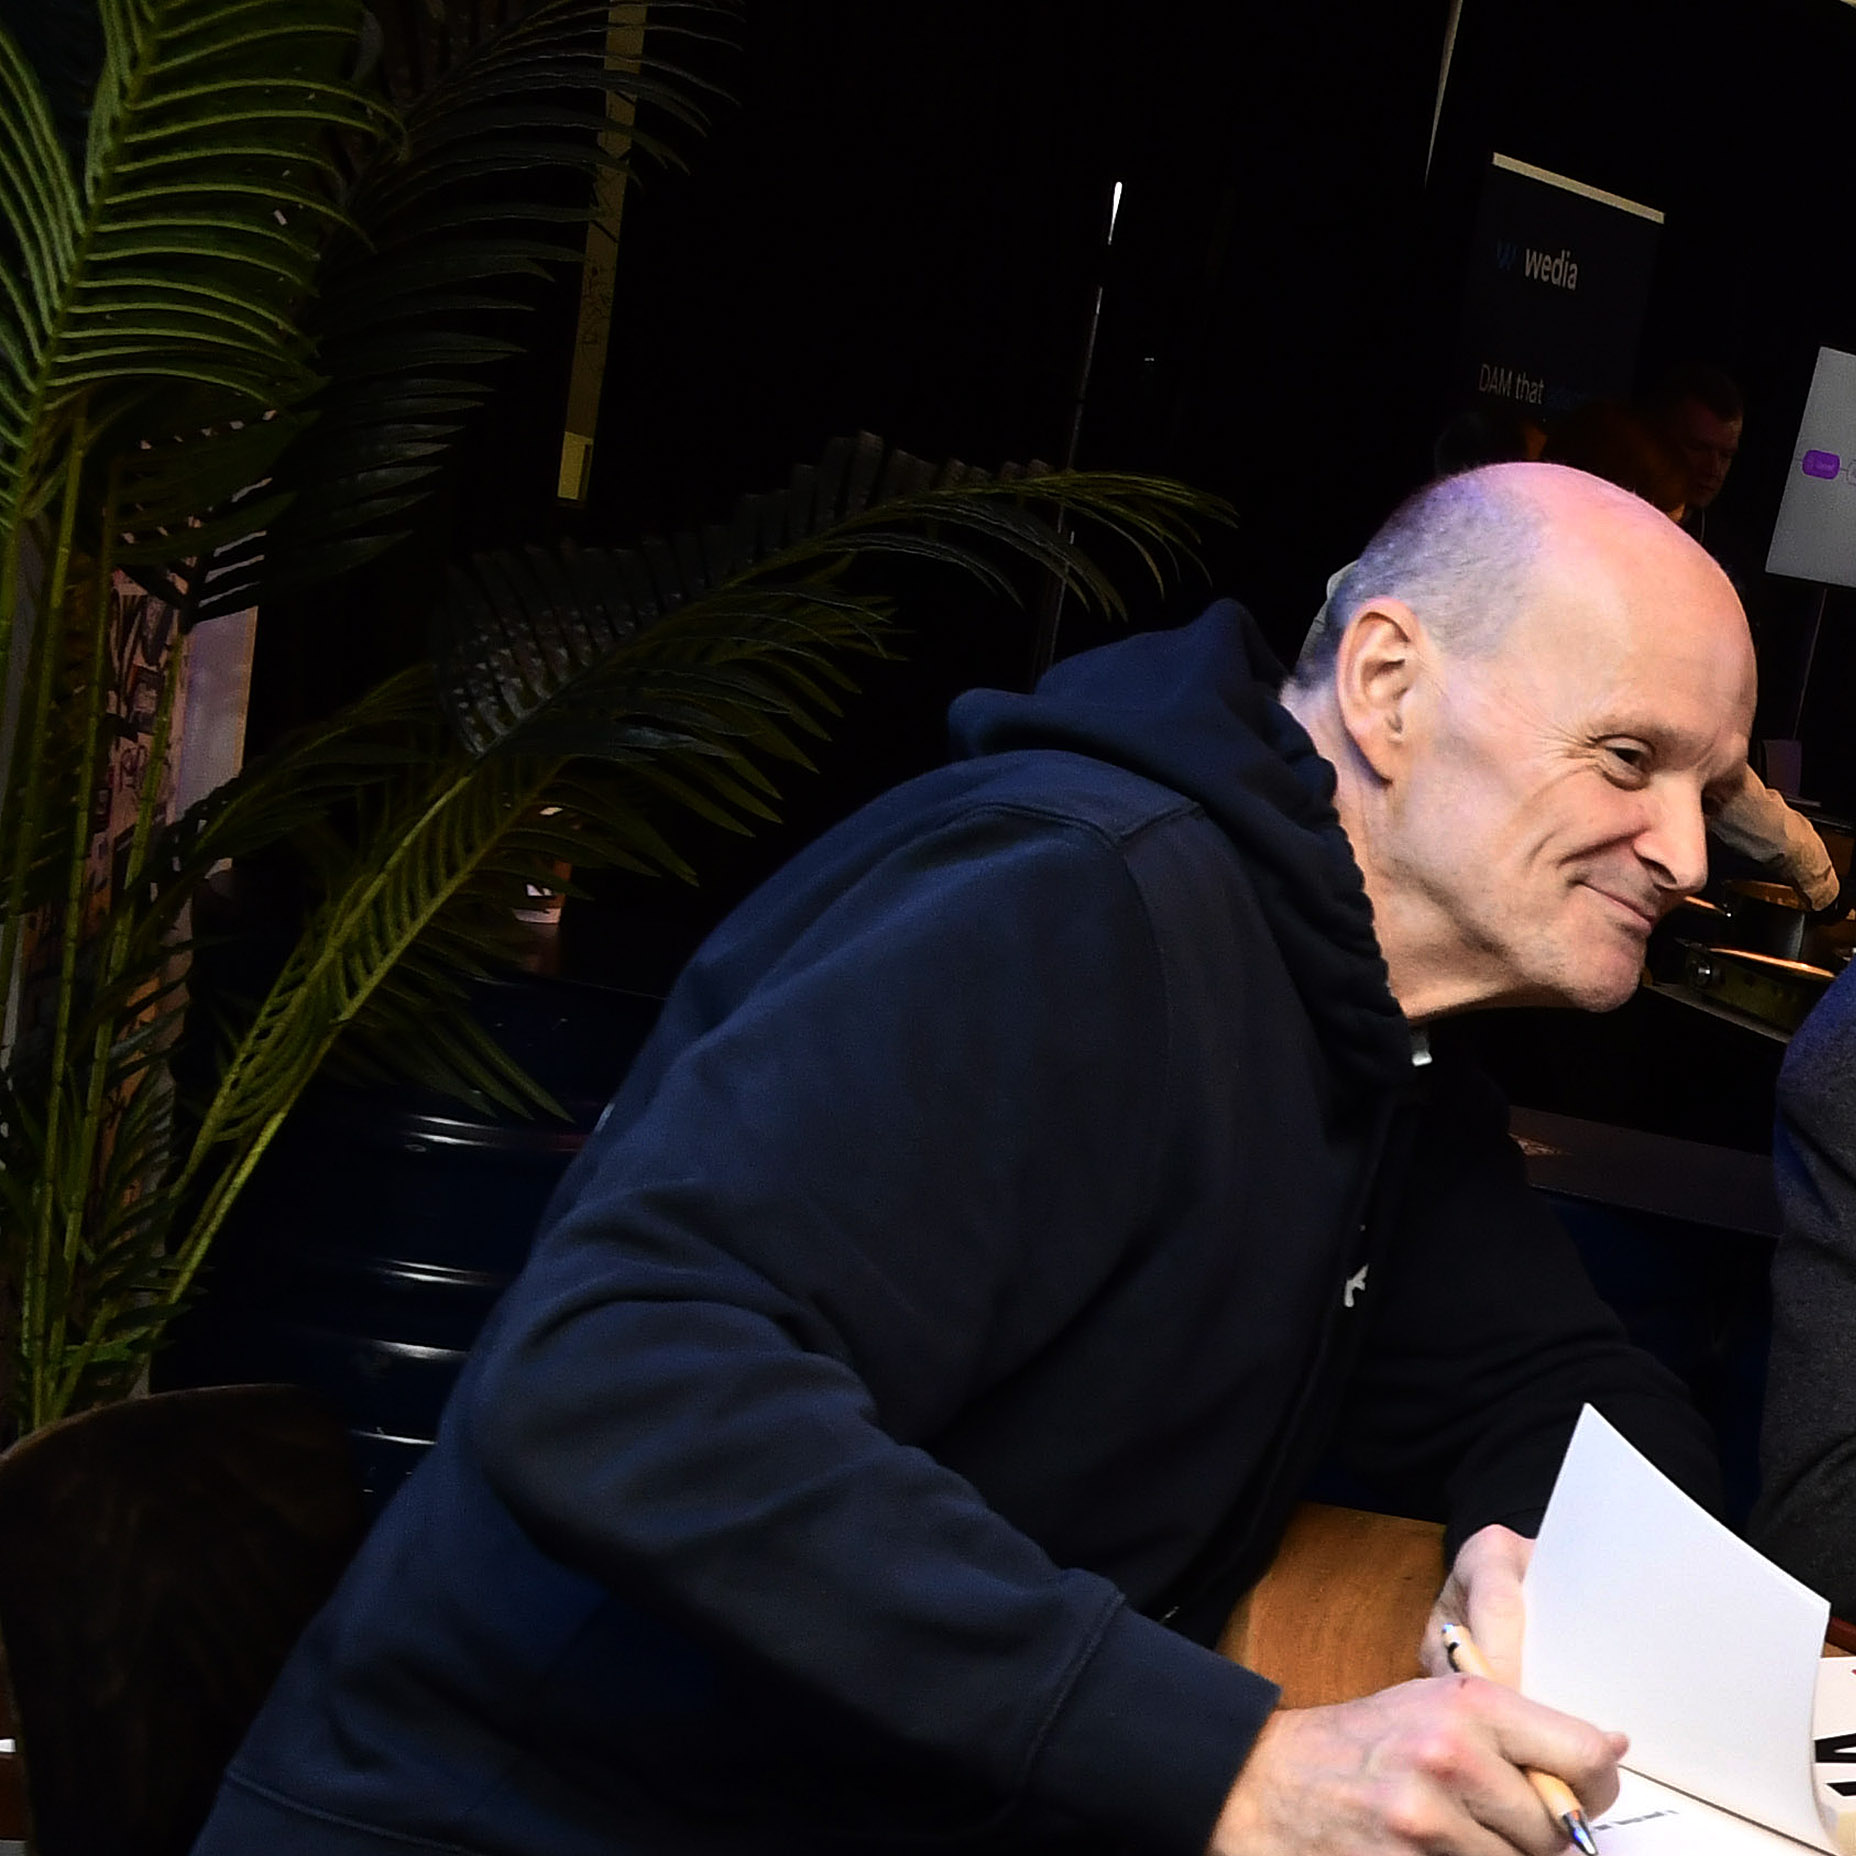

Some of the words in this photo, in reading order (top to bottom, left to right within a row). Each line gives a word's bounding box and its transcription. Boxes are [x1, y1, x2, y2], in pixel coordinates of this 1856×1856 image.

[1524, 248, 1580, 292] wedia
[1478, 363, 1512, 397] DAM
[1514, 372, 1546, 405] that
